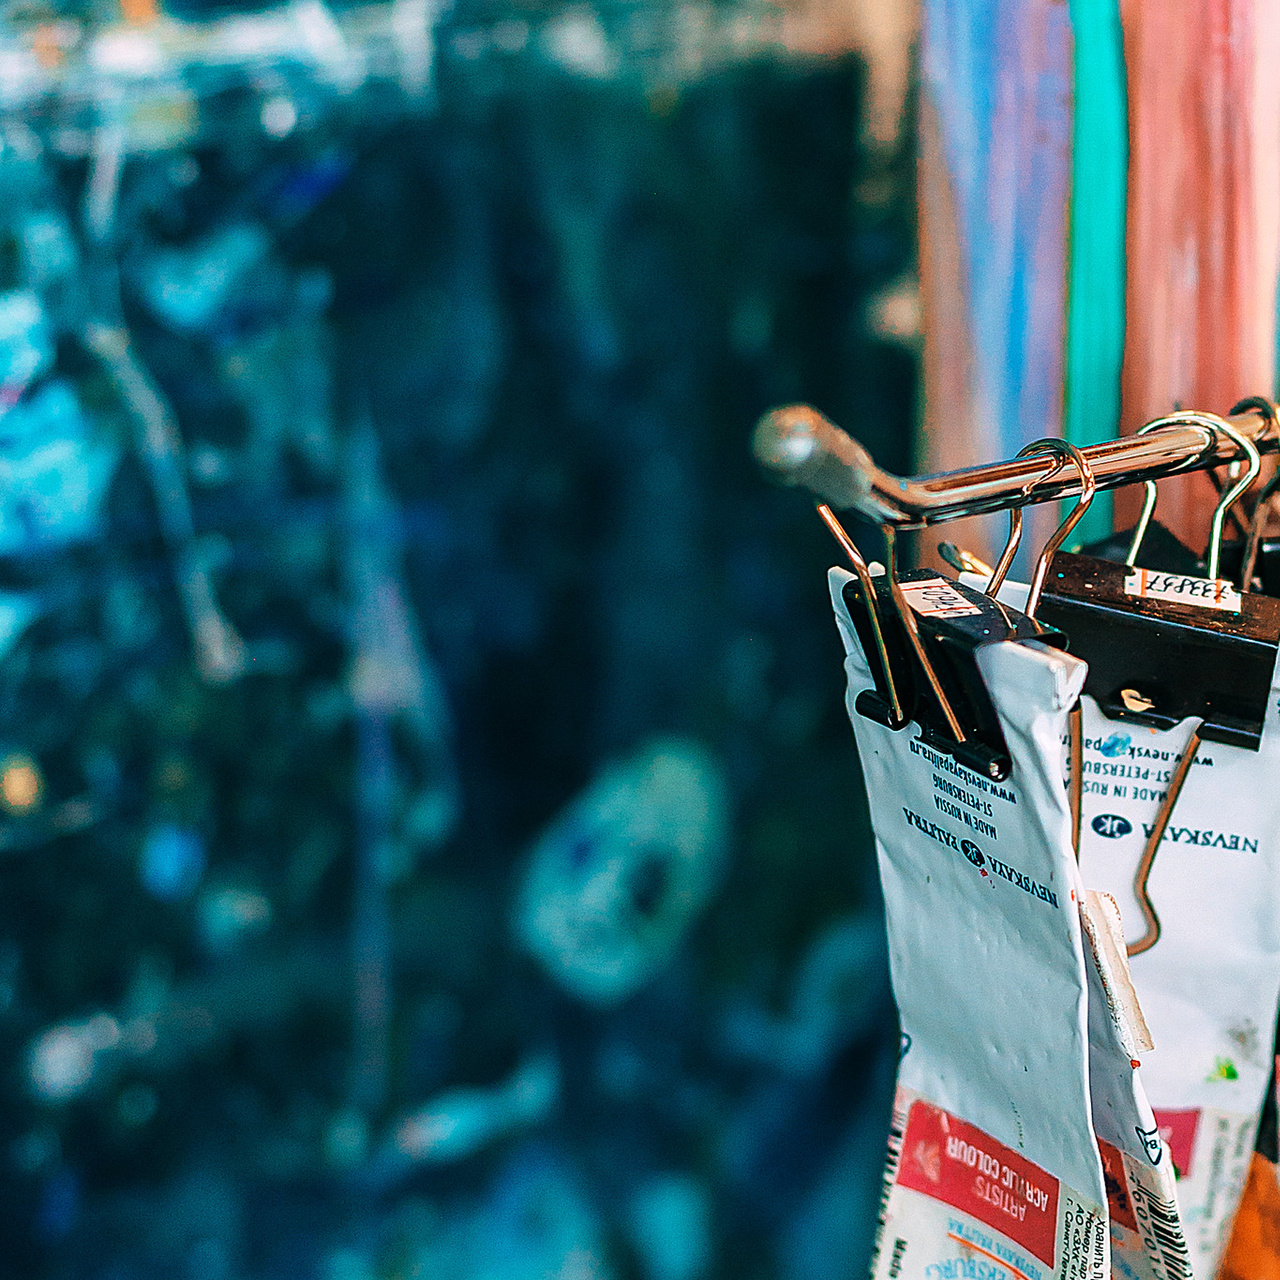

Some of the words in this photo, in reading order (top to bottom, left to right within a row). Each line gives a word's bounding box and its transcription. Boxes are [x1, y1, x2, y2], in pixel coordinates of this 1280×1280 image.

[928, 772, 996, 817] ST-PETERSBURG
[929, 792, 963, 819] RUSSIA
[1111, 783, 1127, 798] IN
[897, 805, 961, 851] PALITRA
[960, 809, 974, 824] IN
[970, 815, 1000, 839] MADE
[981, 853, 1062, 909] NEVSKAYA
[942, 1133, 1003, 1179] COLOUR
[1074, 1202, 1088, 1228] АО
[1079, 1210, 1095, 1255] Номер
[1092, 1217, 1107, 1269] Хранить
